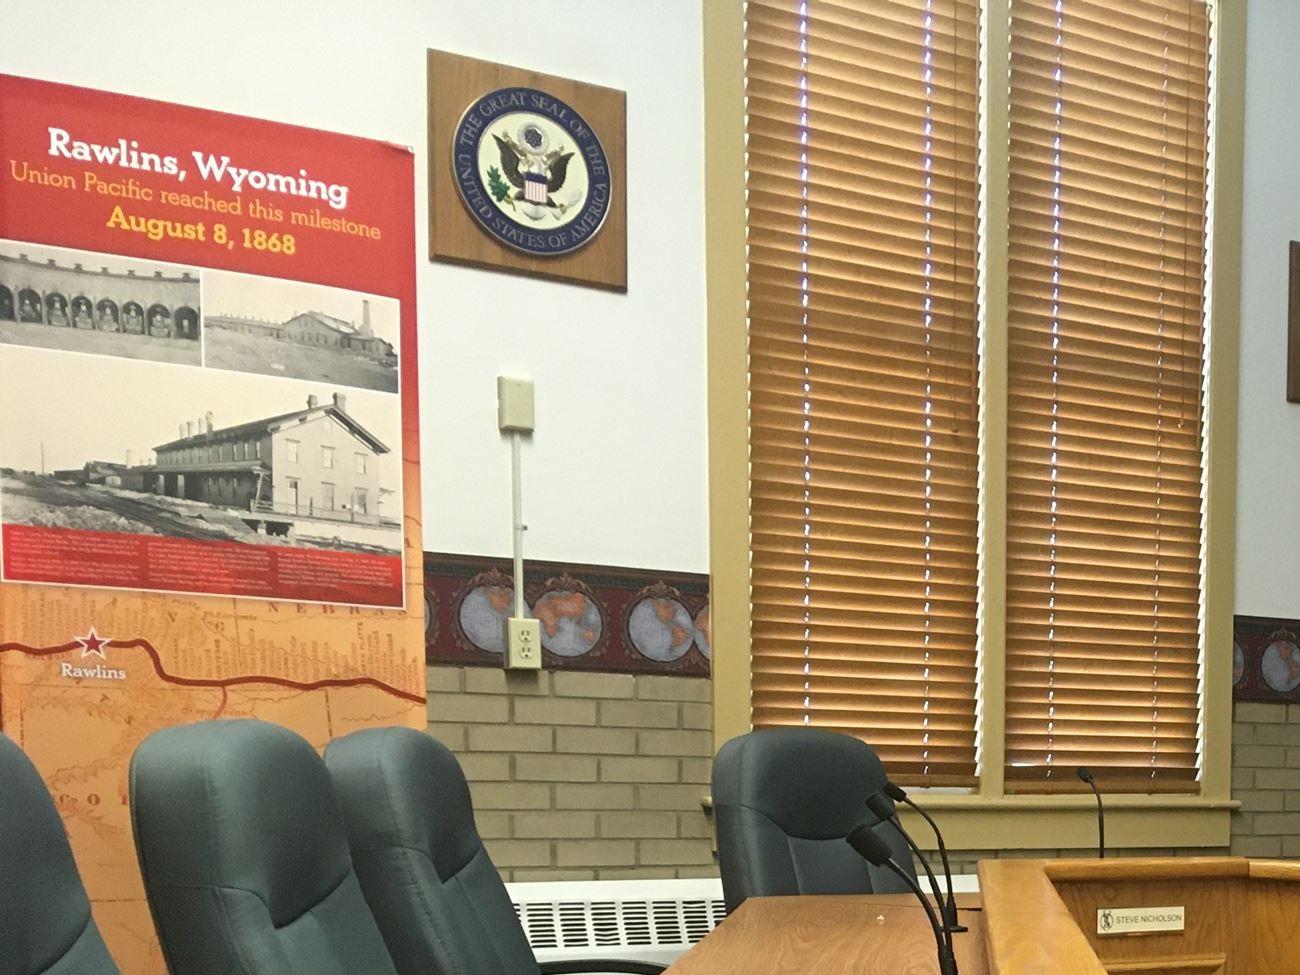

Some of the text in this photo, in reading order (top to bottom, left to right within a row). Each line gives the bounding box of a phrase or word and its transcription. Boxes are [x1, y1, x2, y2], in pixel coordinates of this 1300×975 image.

[47, 127, 349, 209] Rawlins, Wyoming
[459, 92, 606, 177] THE GREAT SEAL OF THE
[10, 160, 382, 241] Union Pacific reached this milestone
[106, 205, 297, 255] August 8, 1868
[458, 152, 607, 248] UNITED STATES OF AMERICA
[61, 662, 127, 679] Rawlins
[1116, 914, 1182, 924] STEVE NICHOLSON
